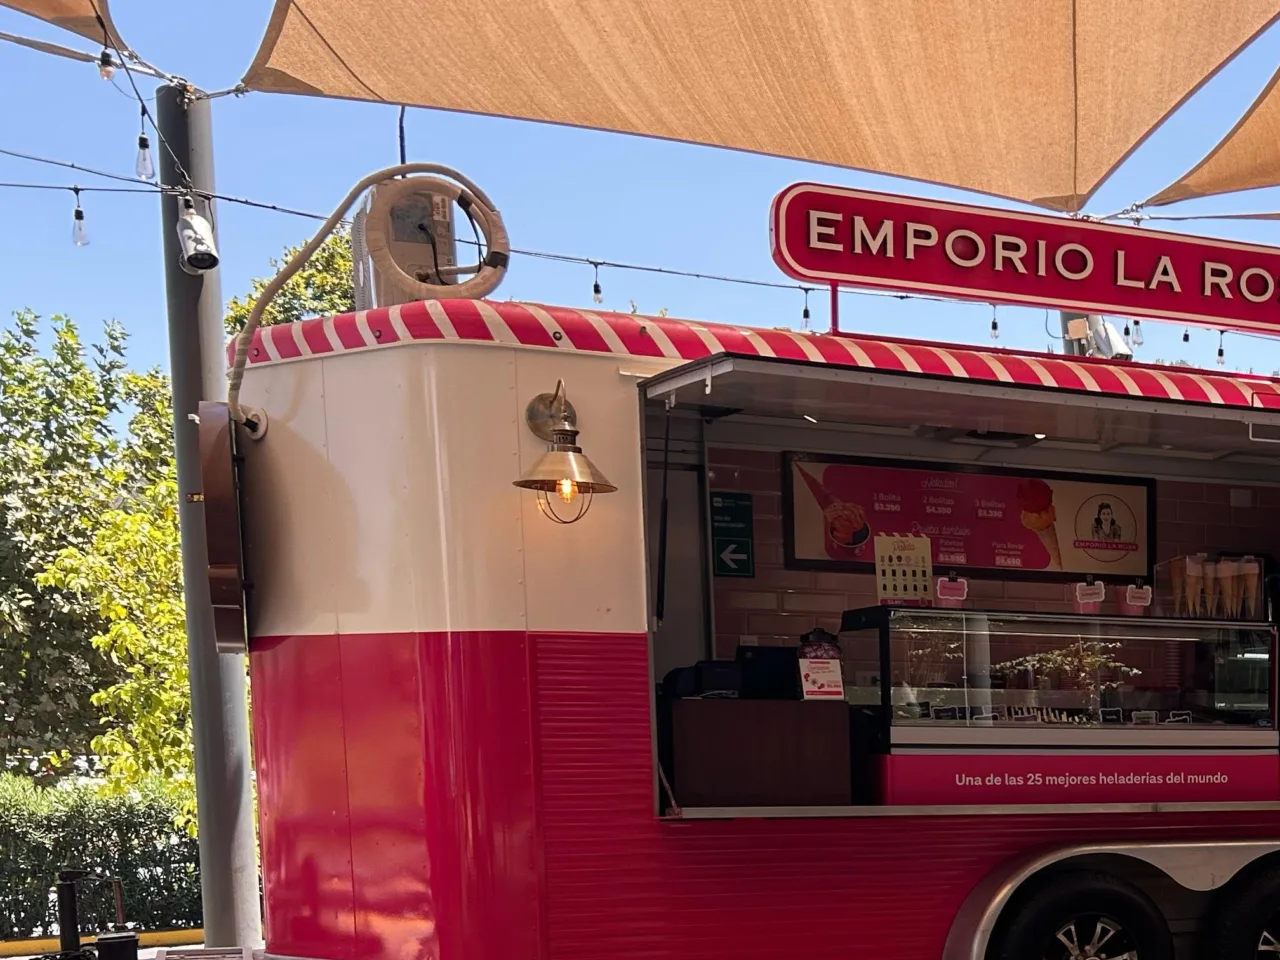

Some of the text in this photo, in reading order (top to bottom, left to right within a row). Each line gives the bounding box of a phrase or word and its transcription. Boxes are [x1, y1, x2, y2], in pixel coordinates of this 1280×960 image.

[807, 208, 1095, 281] EMPORIO
[1115, 249, 1182, 293] LA
[1075, 541, 1107, 549] EMPORIO
[955, 772, 1228, 788] Una de las 25 mejores heladerías del mundo
